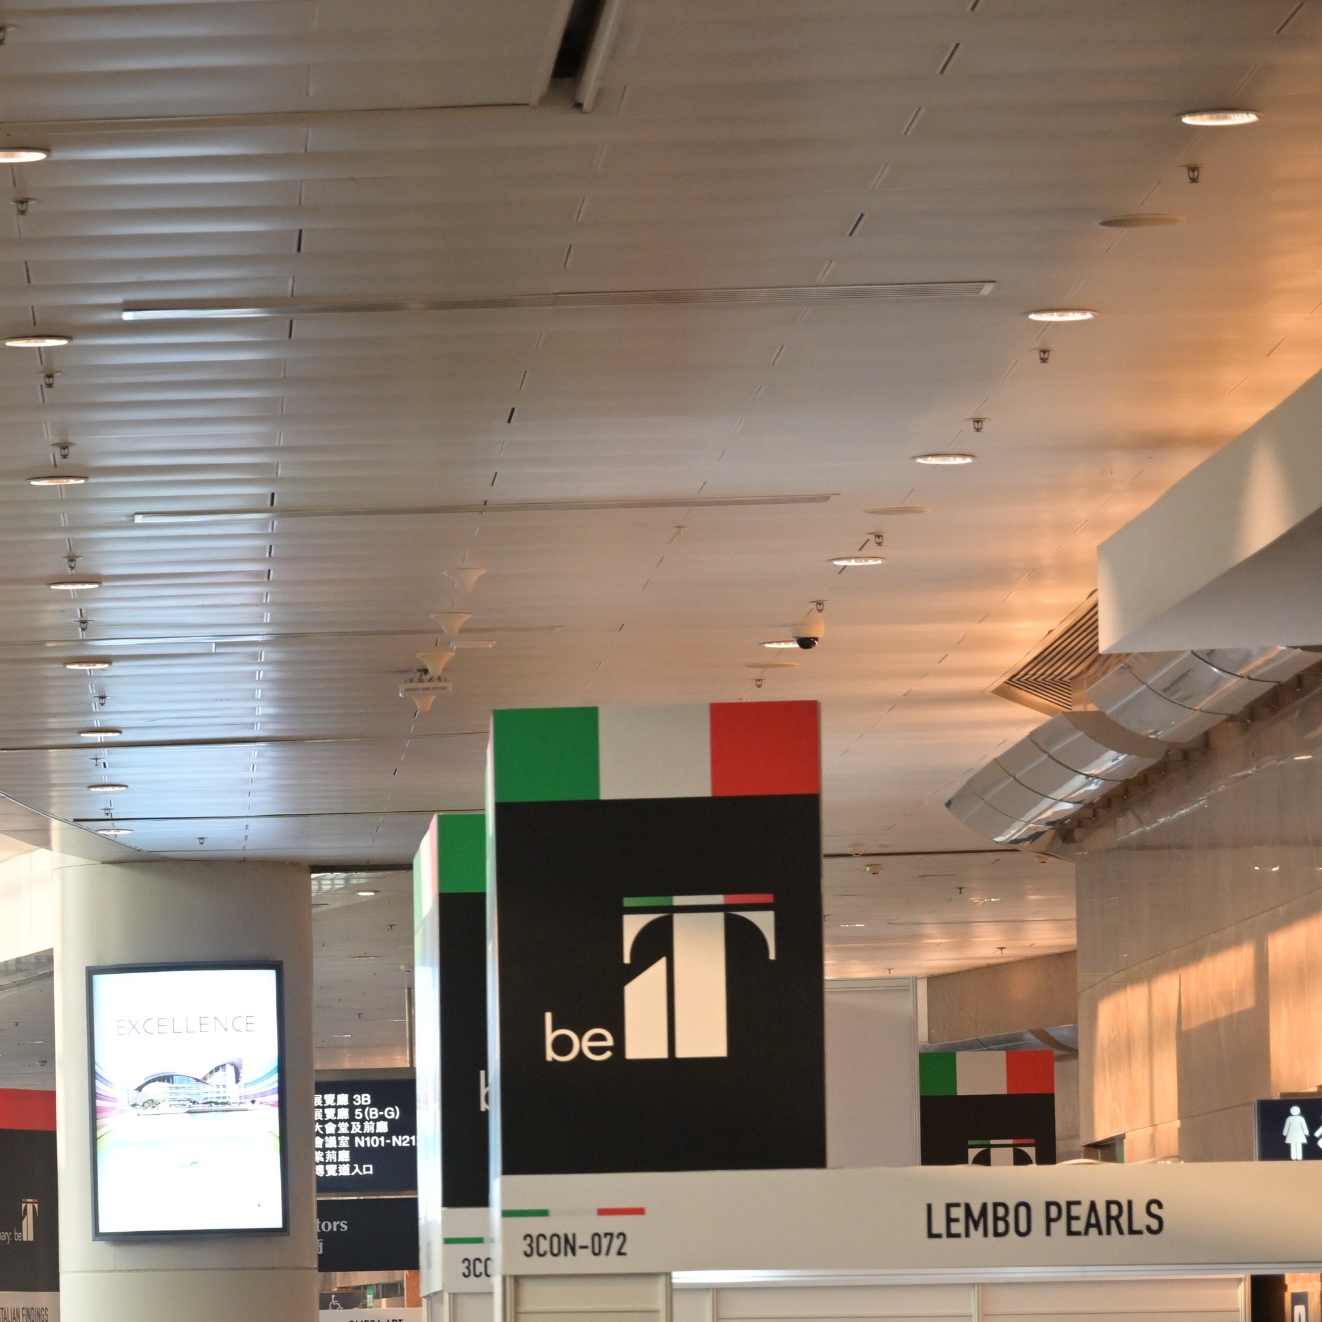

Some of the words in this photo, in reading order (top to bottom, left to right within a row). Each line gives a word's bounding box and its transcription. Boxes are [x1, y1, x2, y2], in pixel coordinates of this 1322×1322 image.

[116, 1015, 255, 1036] EXCELLENCE
[353, 1094, 371, 1106] 3B
[354, 1135, 417, 1147] N101-N21
[926, 1201, 1033, 1239] LEMBO
[1045, 1198, 1164, 1237] PEARLS
[522, 1231, 629, 1259] 3CON-072
